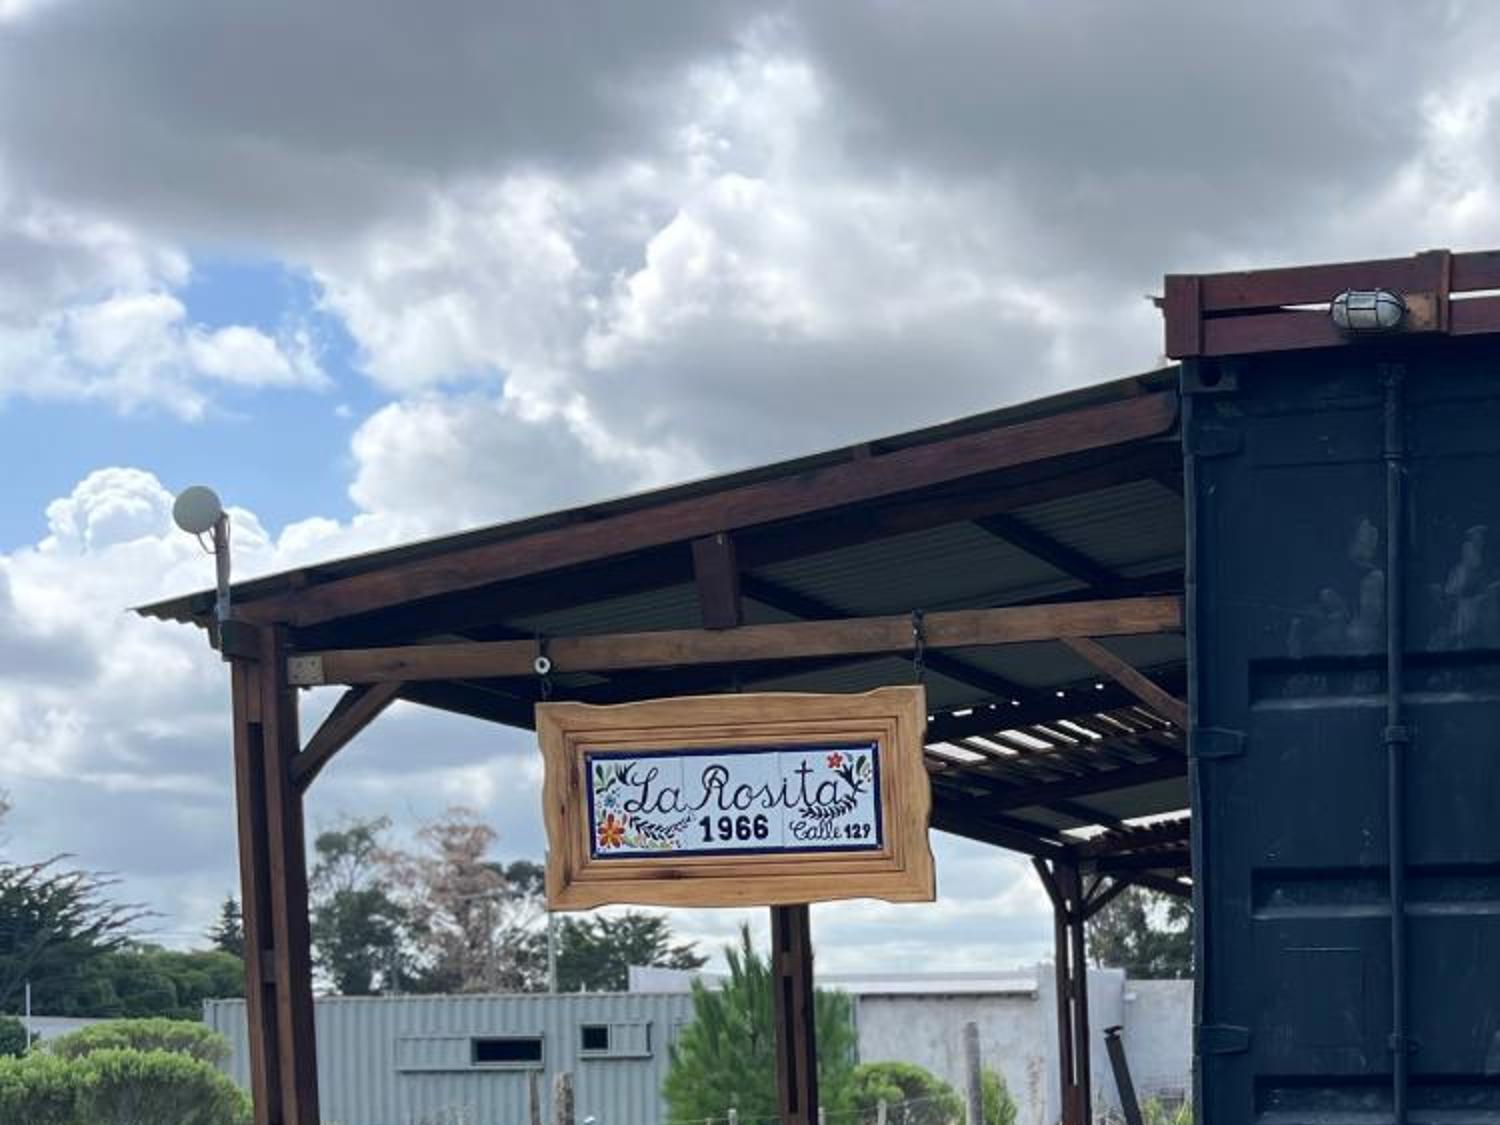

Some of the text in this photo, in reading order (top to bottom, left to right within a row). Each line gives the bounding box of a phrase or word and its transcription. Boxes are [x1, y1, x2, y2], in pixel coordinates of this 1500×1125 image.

[624, 760, 842, 813] La Rosita
[699, 814, 769, 842] 1966
[789, 819, 871, 840] Calle 129
